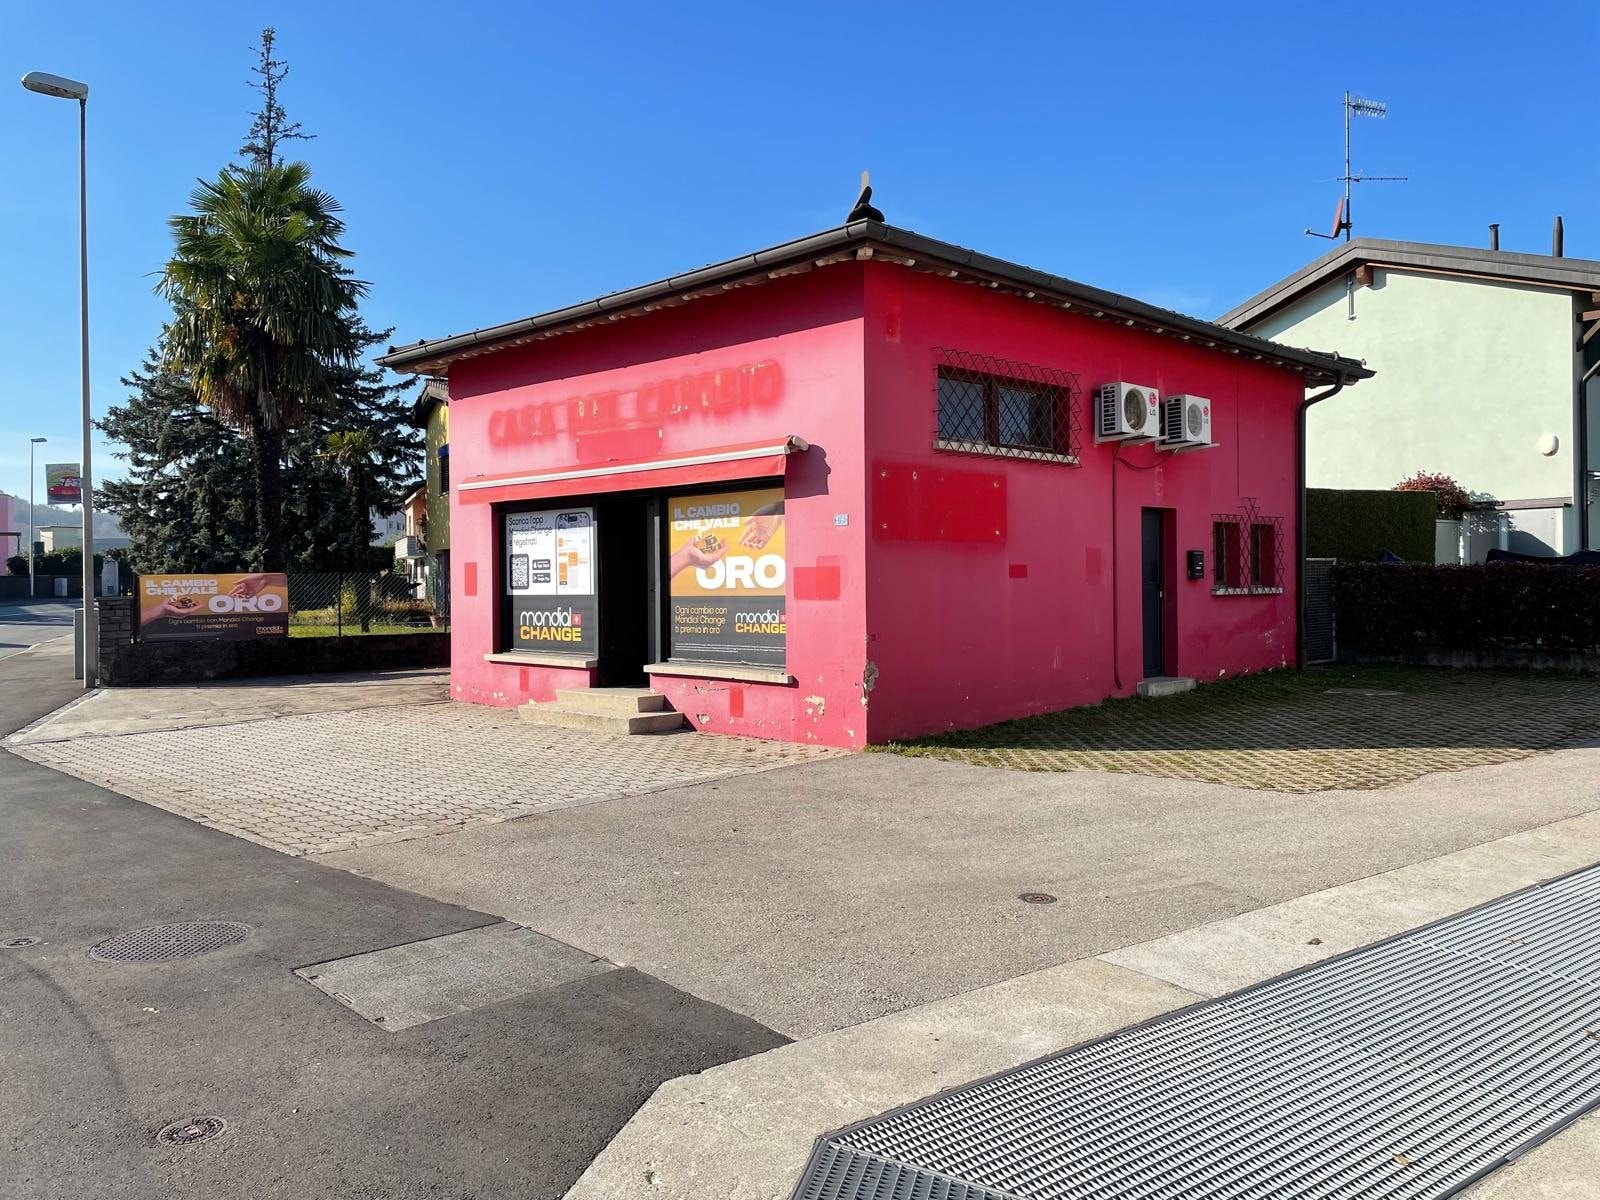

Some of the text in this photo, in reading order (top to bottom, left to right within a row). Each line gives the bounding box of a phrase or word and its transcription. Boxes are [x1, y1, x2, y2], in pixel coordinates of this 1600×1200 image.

[674, 503, 740, 518] IL CAMBIO
[674, 516, 740, 531] CHE VALE
[696, 554, 786, 590] ORO
[145, 579, 218, 588] IL CAMBIO
[146, 586, 218, 596] CHE VALE
[208, 594, 282, 613] ORO
[520, 607, 572, 627] mondial
[675, 605, 728, 617] Ogni cambio con
[735, 609, 780, 624] mondial
[219, 615, 240, 623] Mondial
[242, 614, 264, 623] Change
[675, 614, 725, 626] Mondial Change
[520, 625, 582, 642] CHANGE
[680, 626, 702, 635] premia
[703, 625, 709, 634] in
[735, 623, 786, 634] CHANGE
